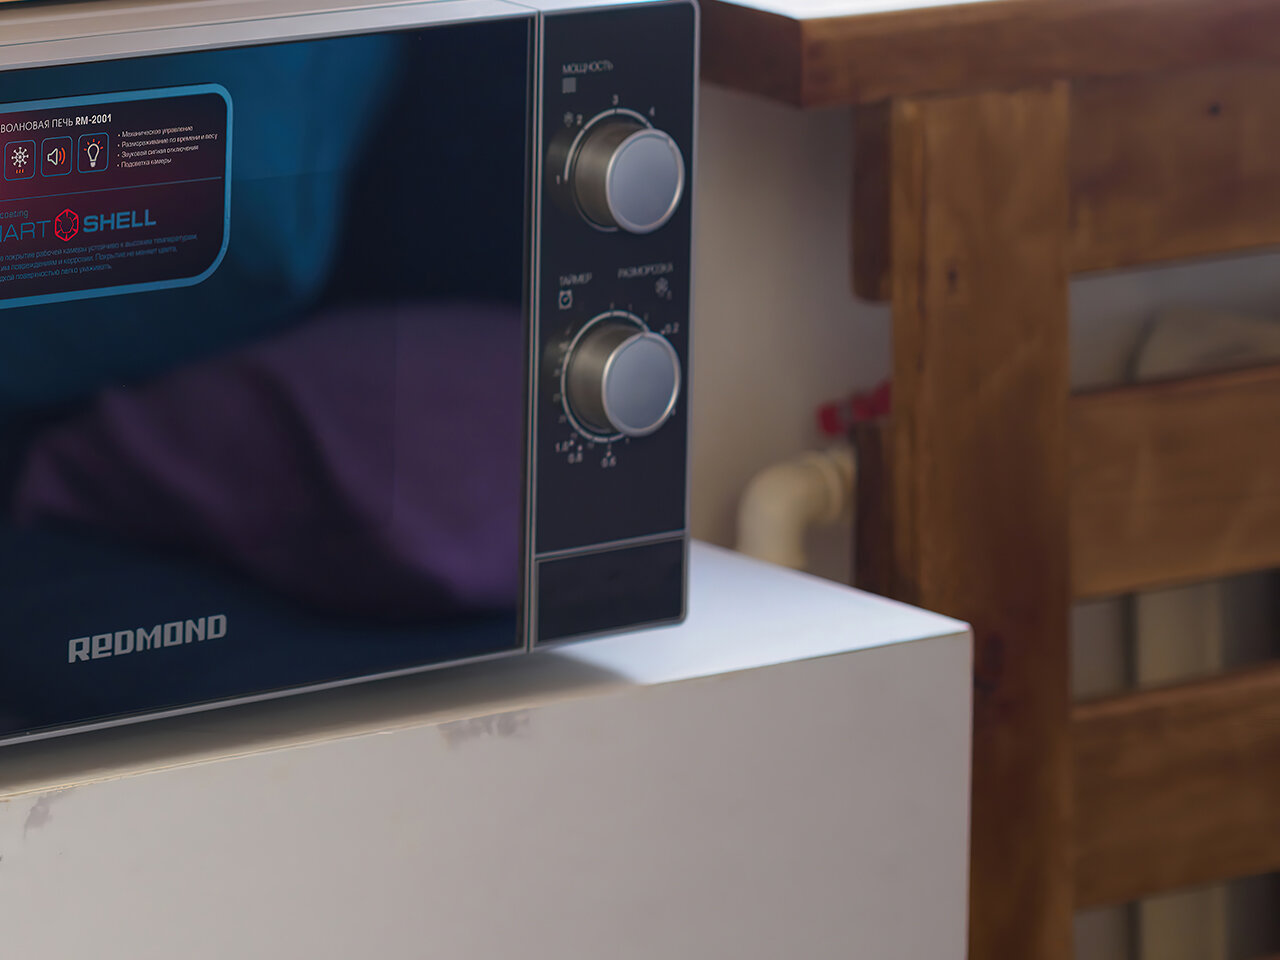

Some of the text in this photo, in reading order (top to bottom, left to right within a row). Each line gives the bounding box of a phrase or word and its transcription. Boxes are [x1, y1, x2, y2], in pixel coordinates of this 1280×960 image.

[52, 118, 74, 129] ПЕЧЬ
[75, 113, 112, 126] RM-2001
[0, 209, 29, 219] coating
[83, 209, 157, 232] SHELL
[68, 614, 227, 664] REDMOND
